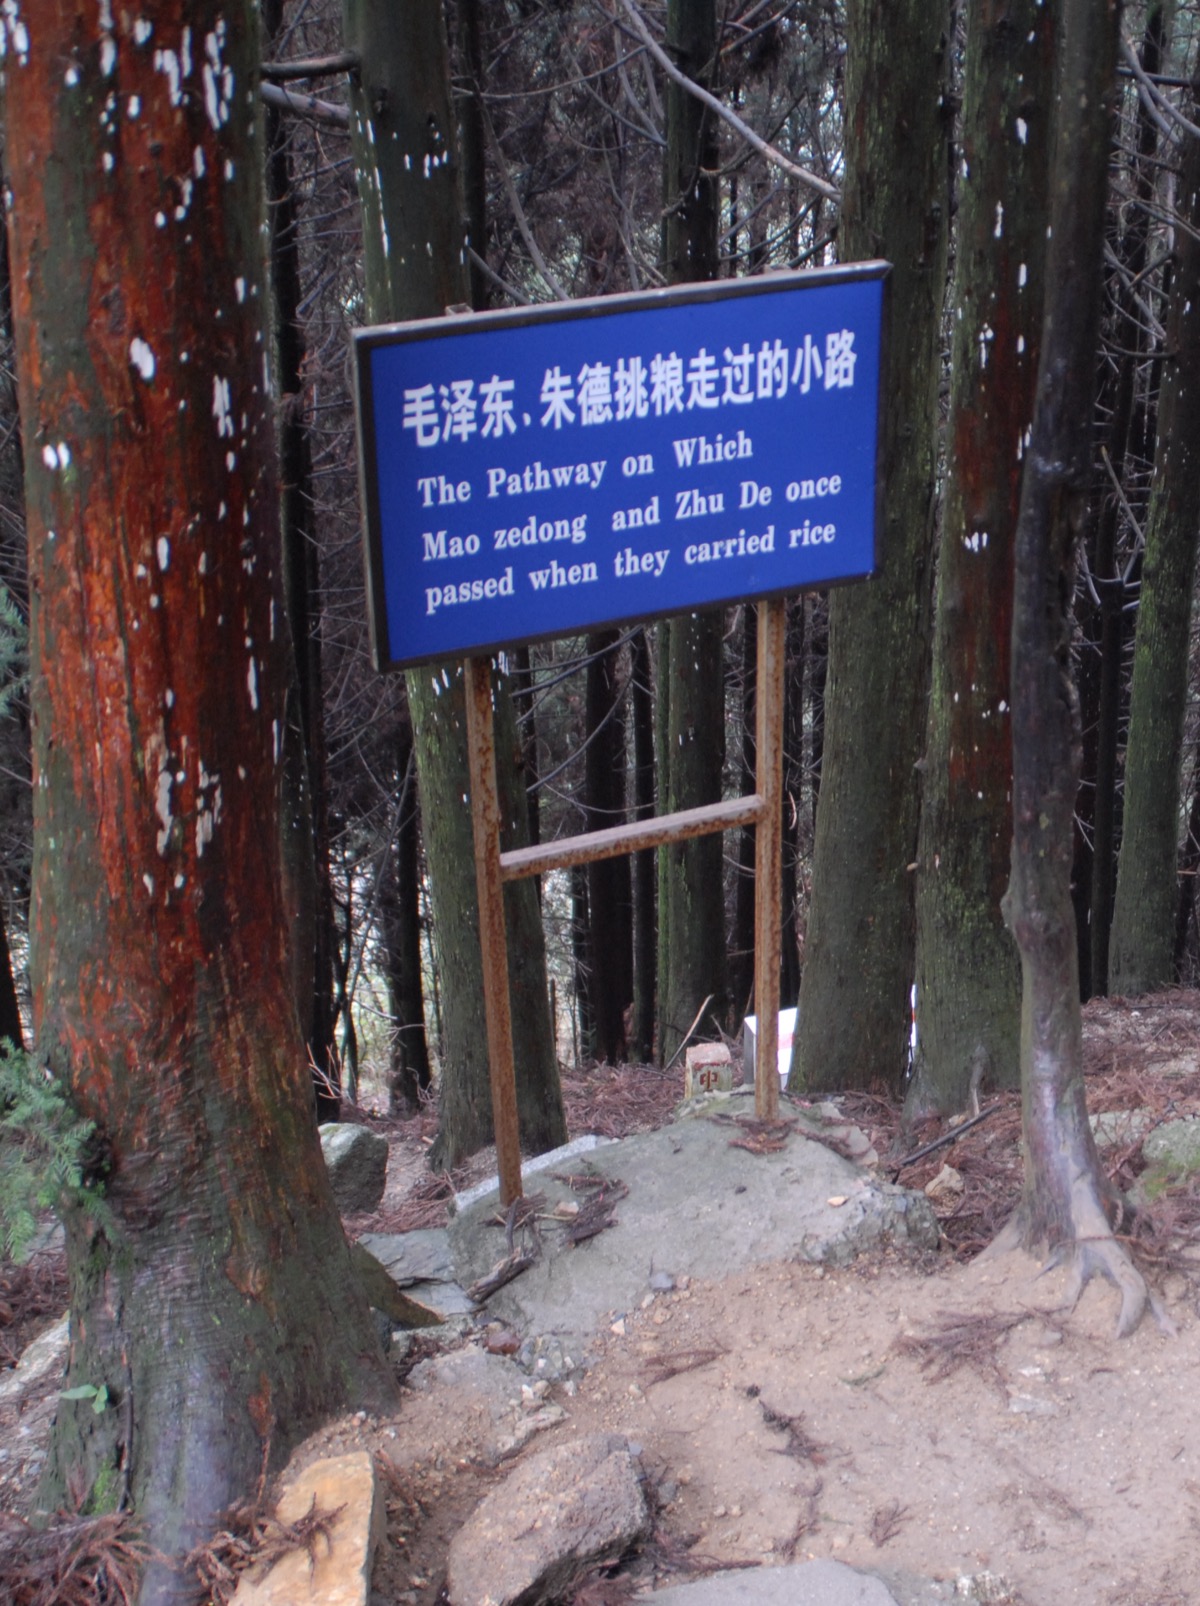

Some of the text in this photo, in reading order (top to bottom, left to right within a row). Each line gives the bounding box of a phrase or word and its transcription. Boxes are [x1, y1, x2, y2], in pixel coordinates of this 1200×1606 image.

[403, 329, 856, 447] 毛泽东、朱德挑粮走过的小路
[418, 431, 753, 507] The Pathway on Which
[423, 475, 842, 561] Mao zedong and Zhu De once
[426, 520, 836, 614] passed when they carried rice
